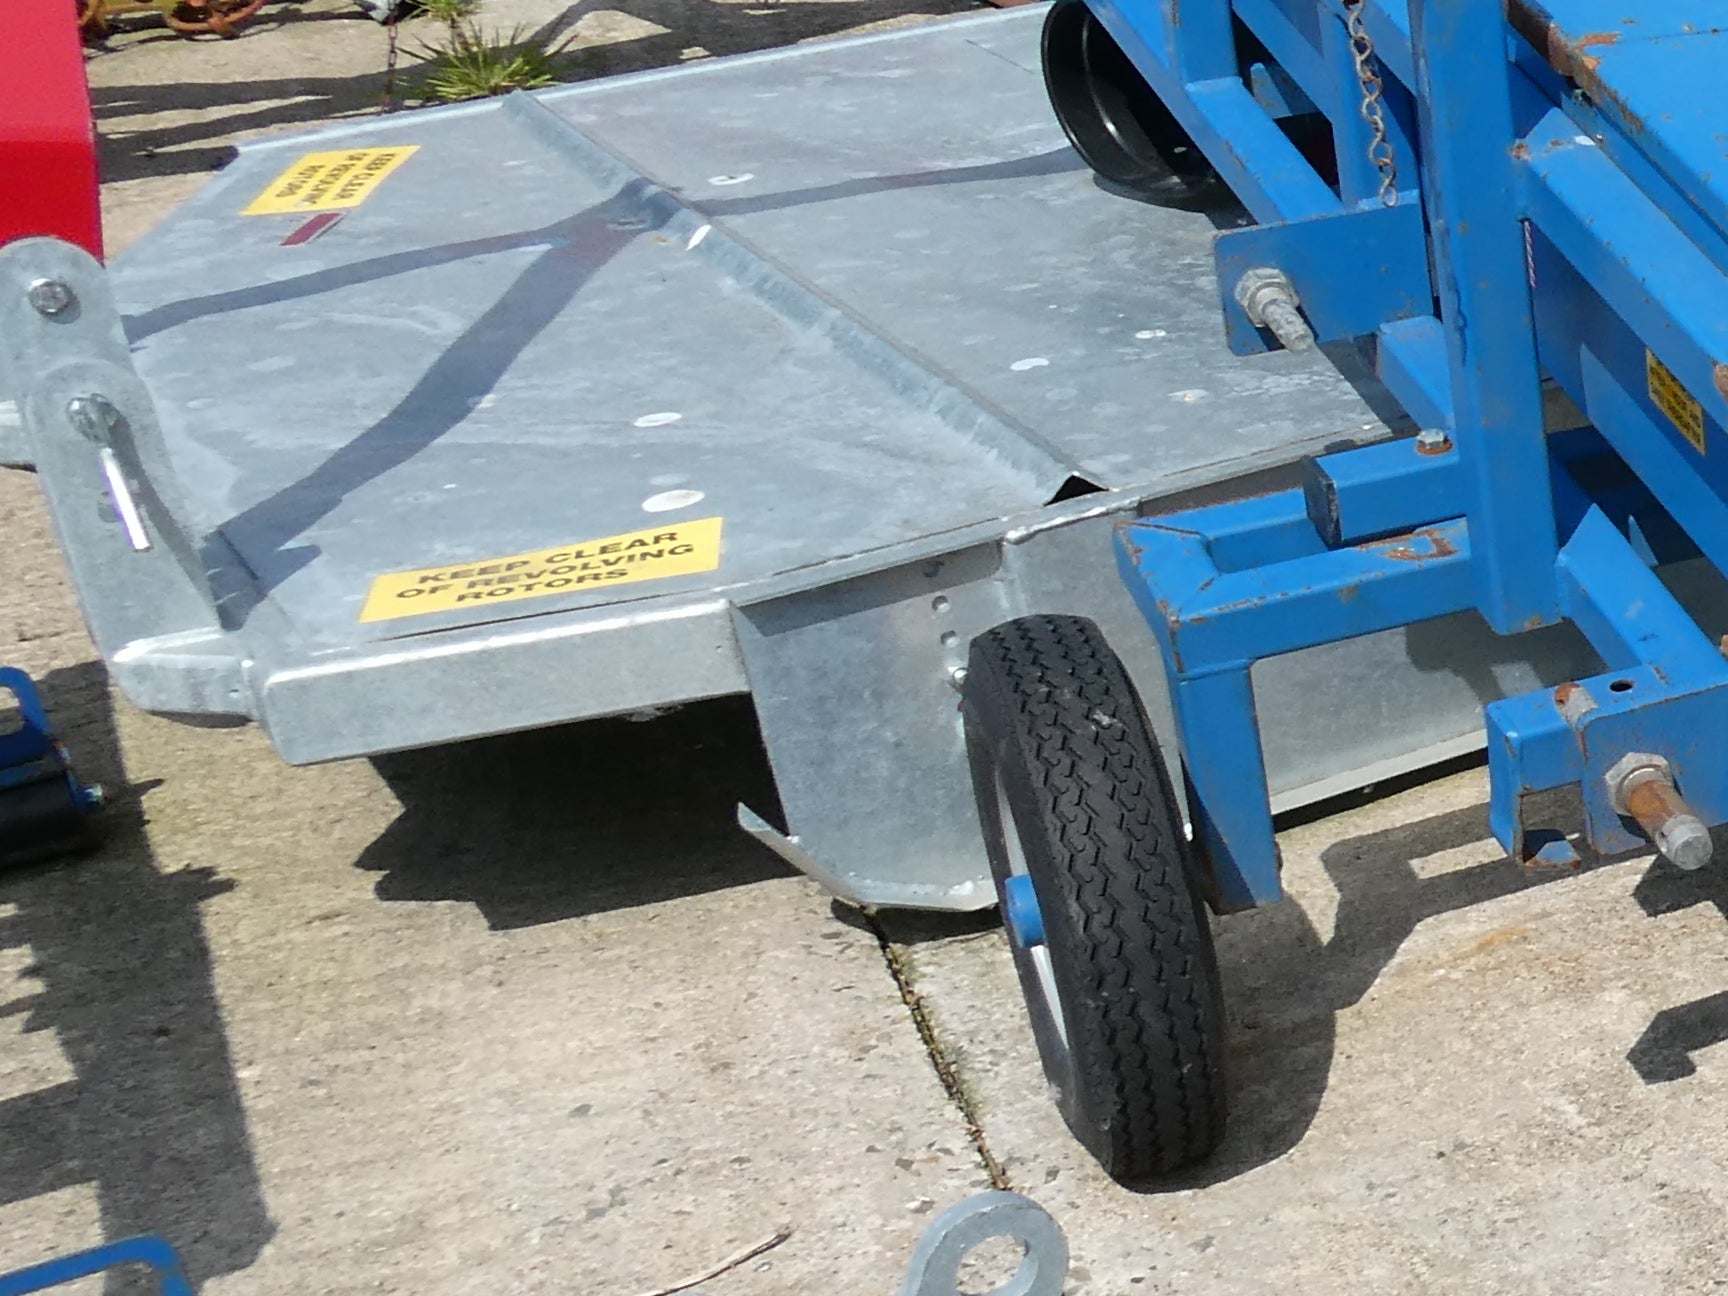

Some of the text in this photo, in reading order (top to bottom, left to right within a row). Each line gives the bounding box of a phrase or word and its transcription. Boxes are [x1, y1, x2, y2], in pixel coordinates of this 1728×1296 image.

[395, 543, 695, 600] OF REVOLVING
[417, 531, 679, 585] KEEP CLEAR
[454, 568, 629, 603] ROTORS
